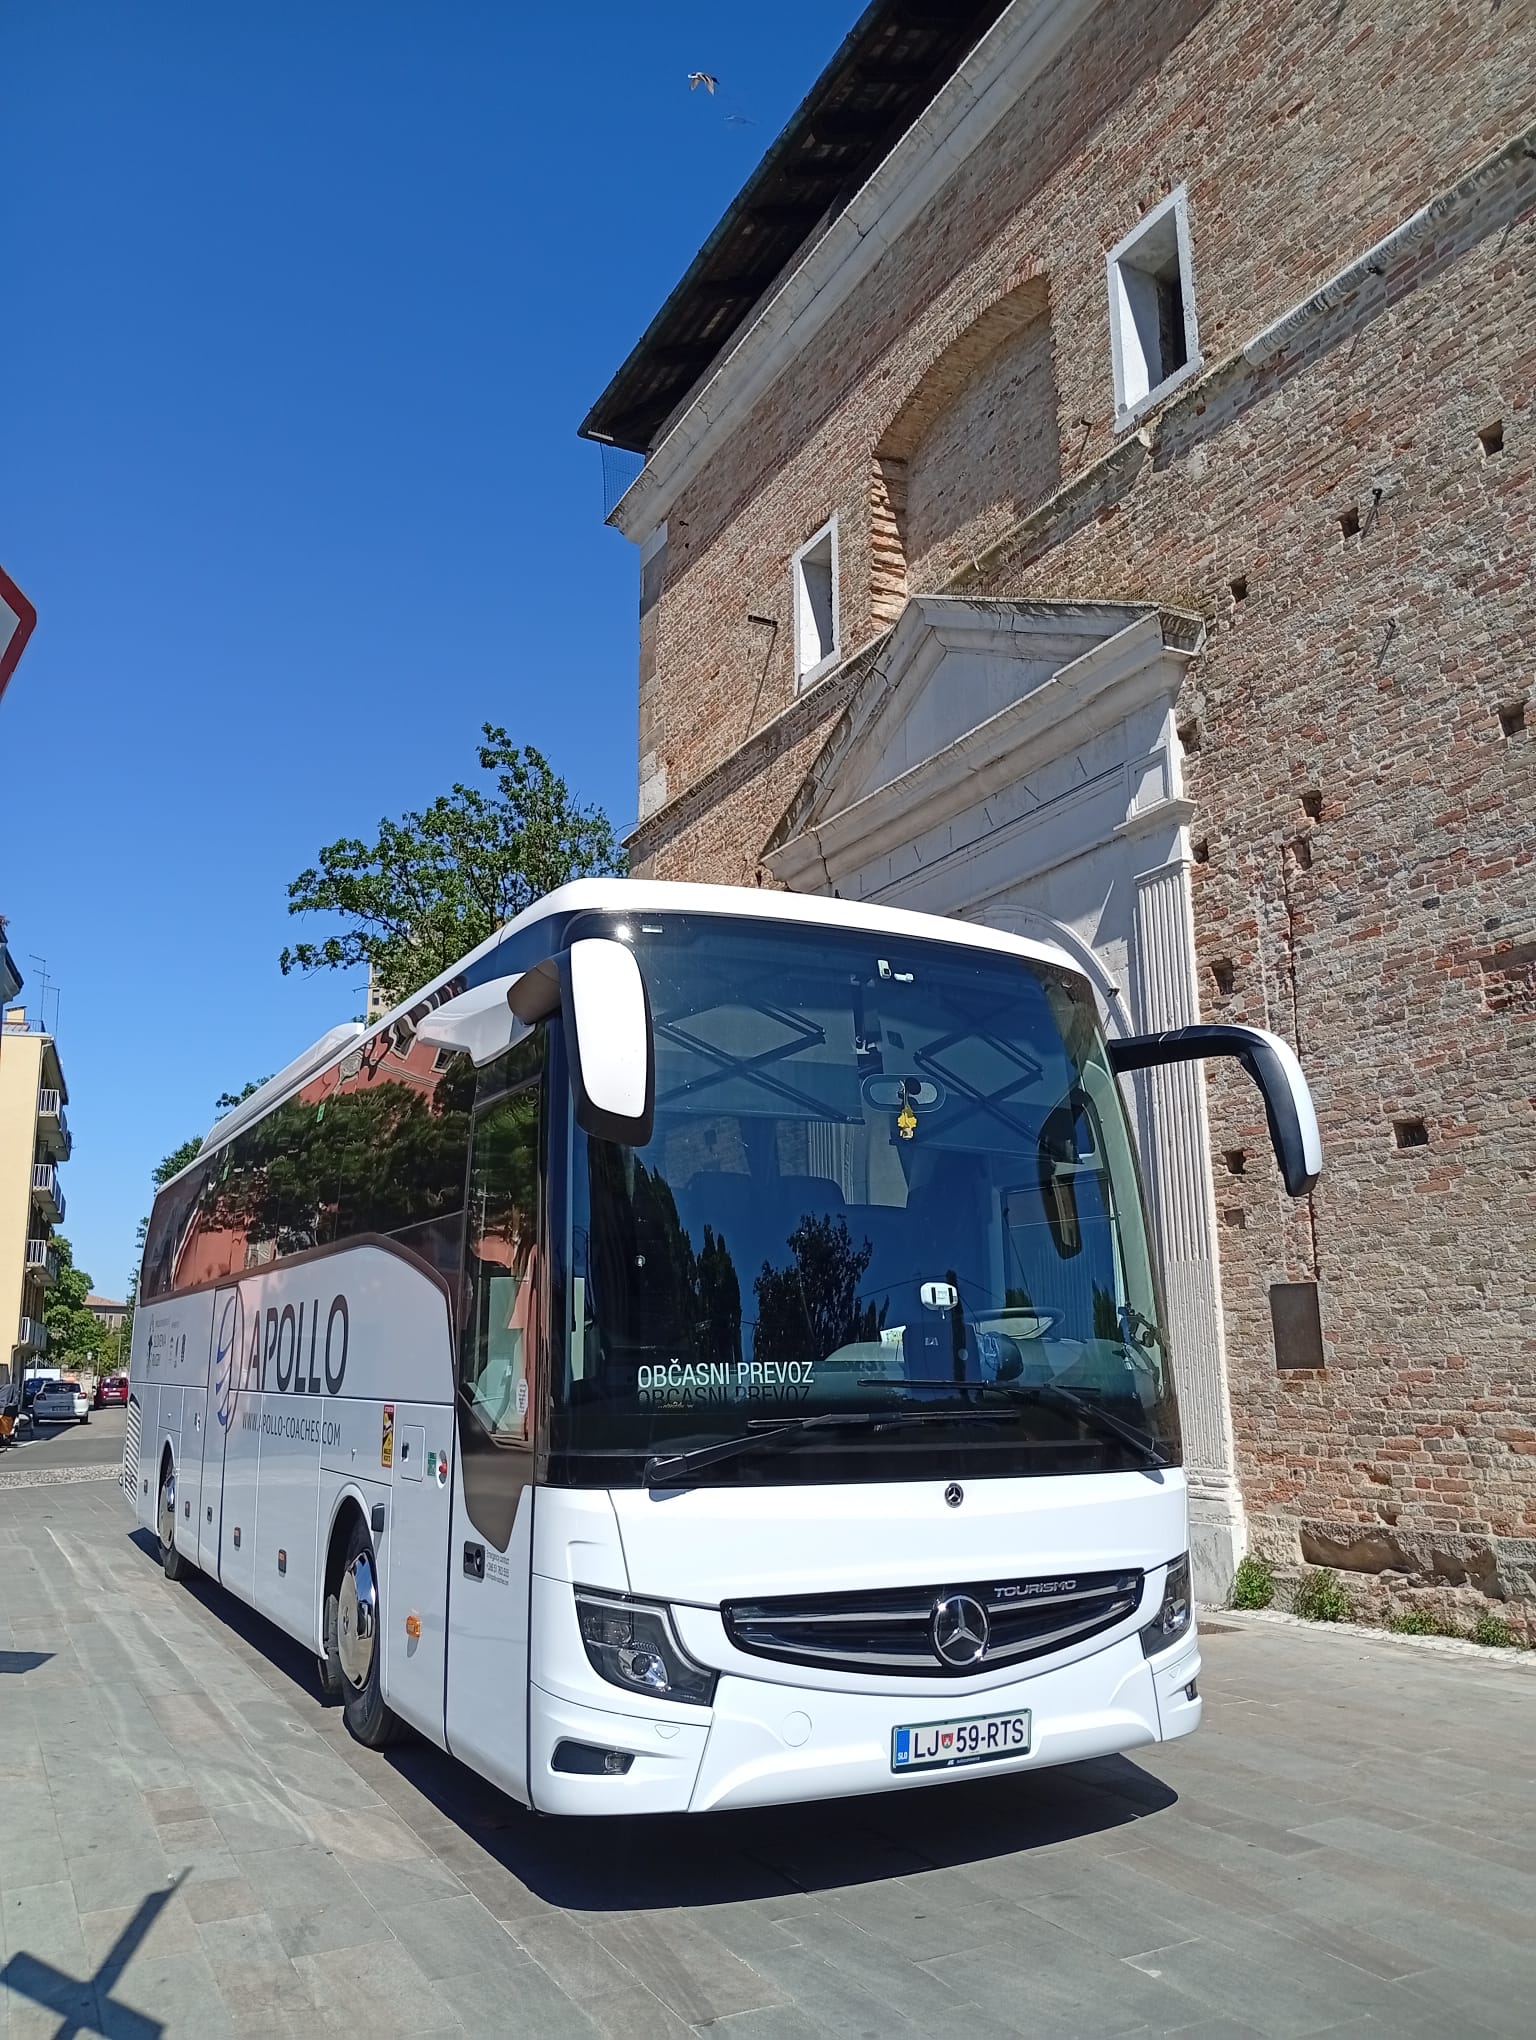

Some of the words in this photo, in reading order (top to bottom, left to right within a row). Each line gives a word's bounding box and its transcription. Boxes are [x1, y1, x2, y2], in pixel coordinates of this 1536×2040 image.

[244, 1293, 350, 1395] APOLLO
[637, 1358, 730, 1389] OBČASNI
[737, 1361, 815, 1385] PREVOZ
[242, 1412, 341, 1447] WWW.APOLLO-COACHESCOM
[913, 1729, 940, 1759] LJ
[956, 1718, 1024, 1753] 59-RTS
